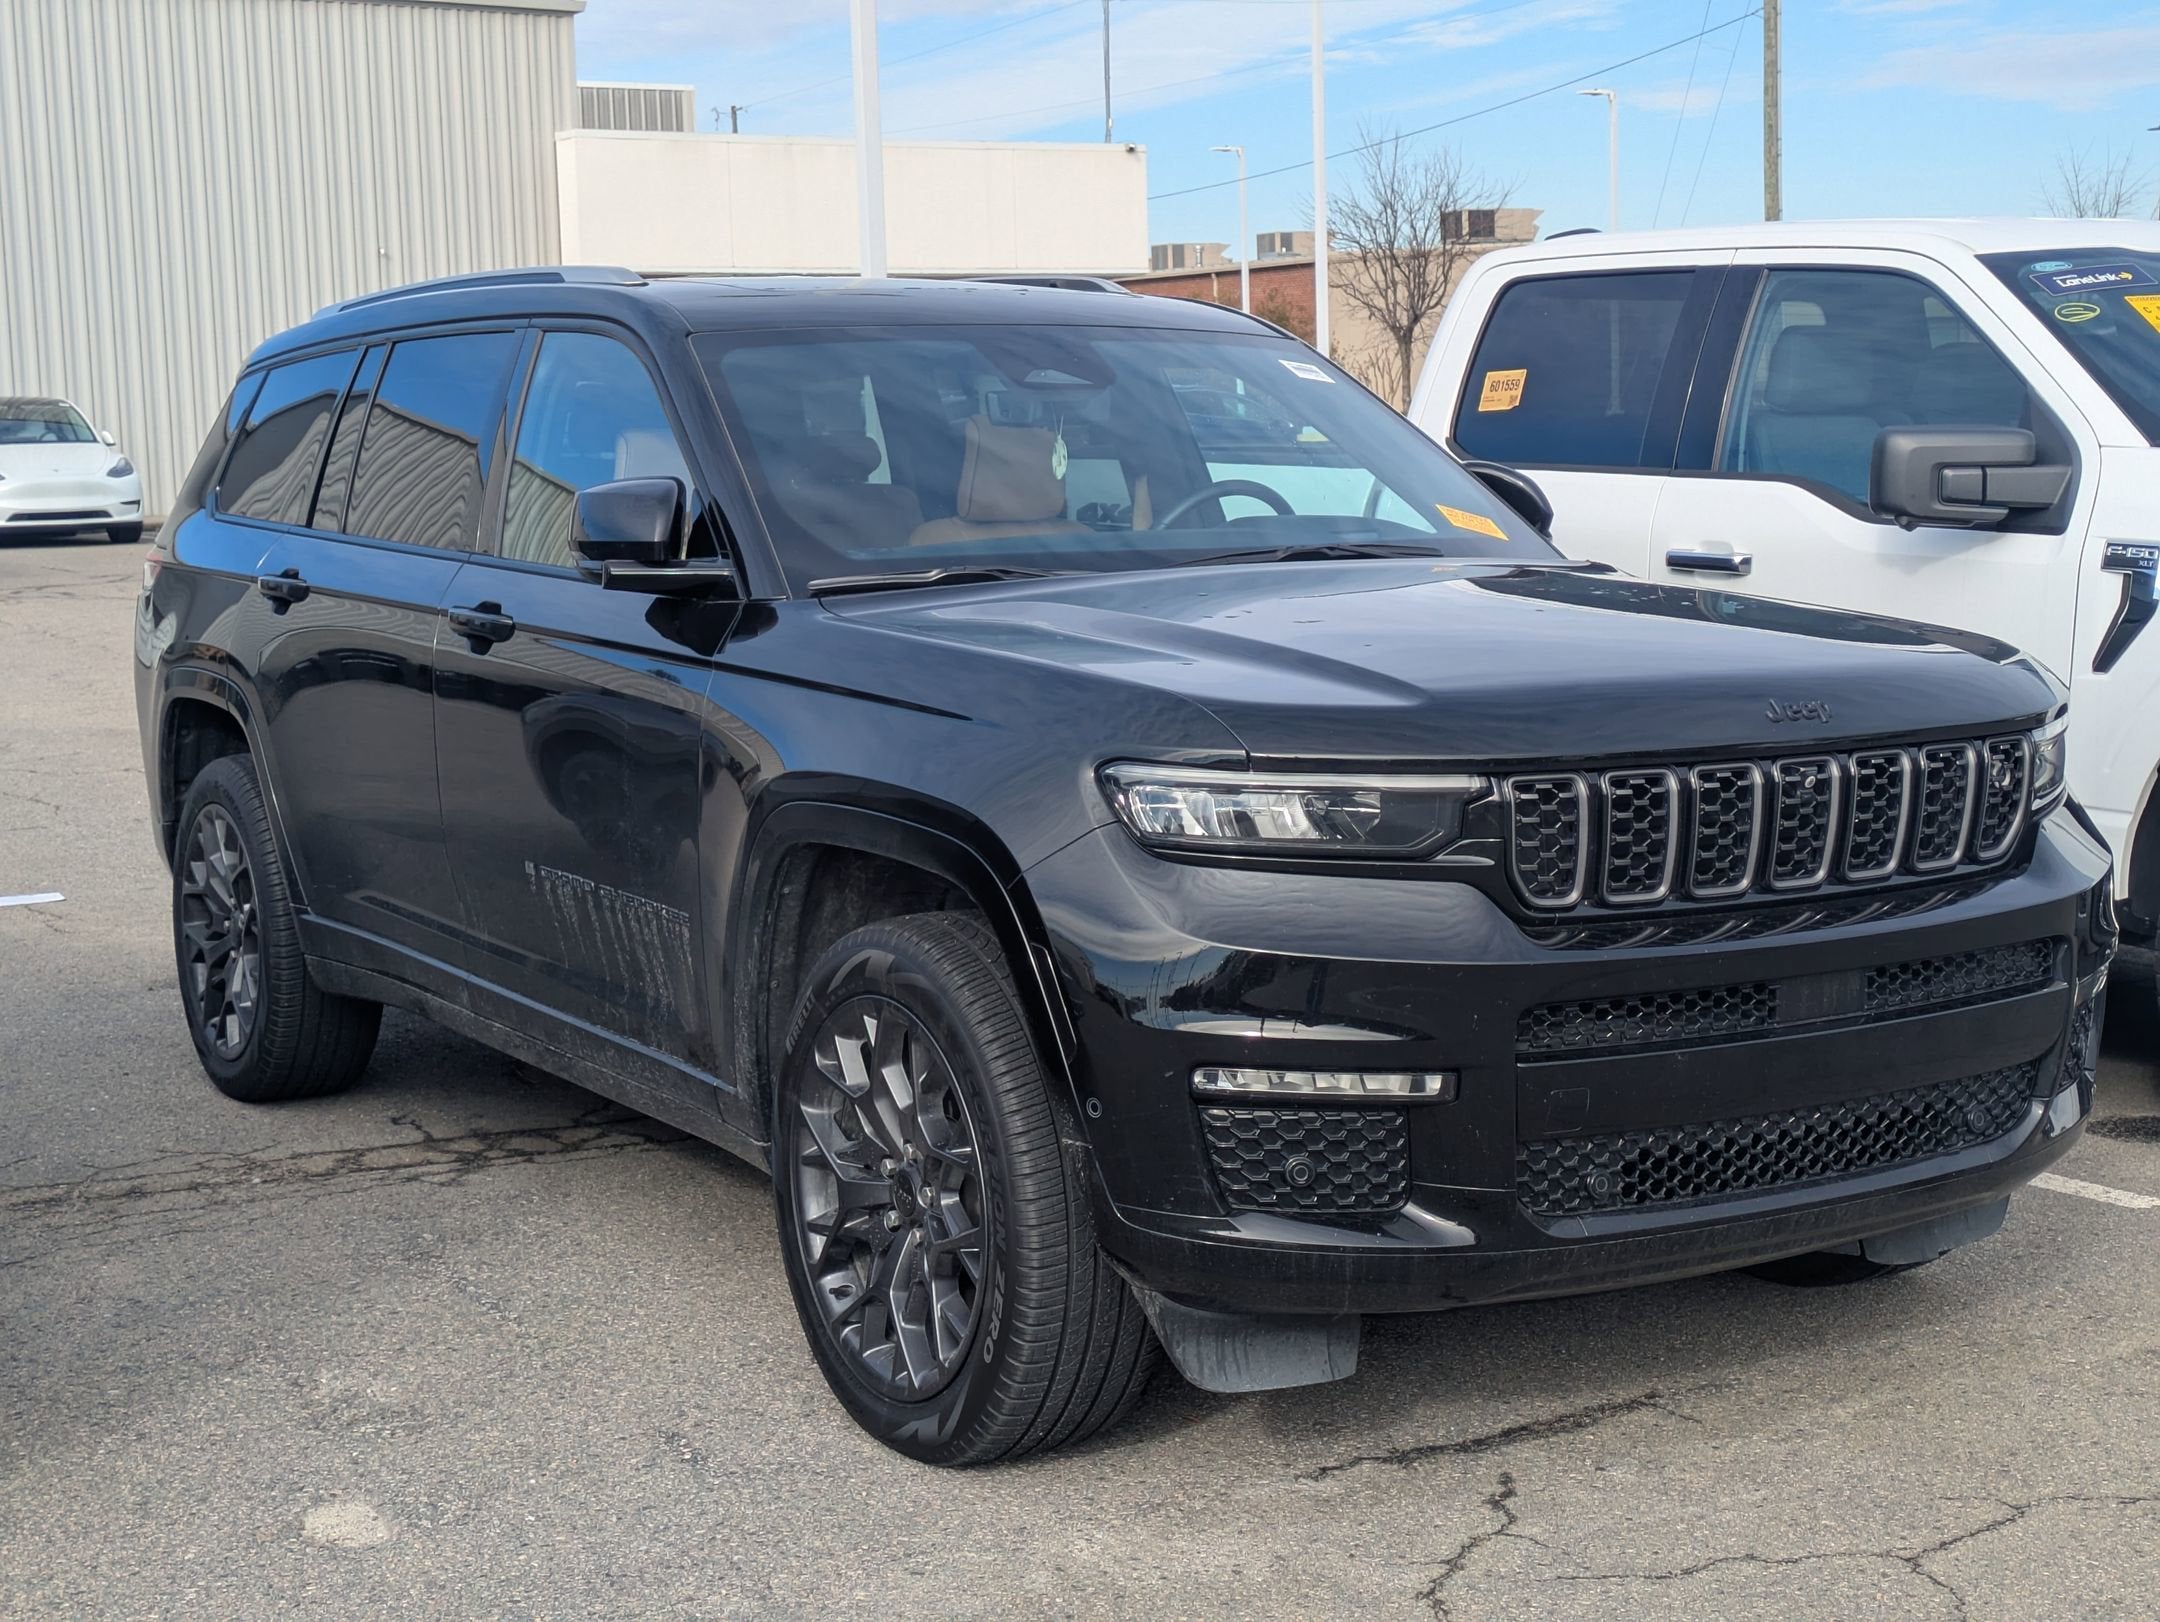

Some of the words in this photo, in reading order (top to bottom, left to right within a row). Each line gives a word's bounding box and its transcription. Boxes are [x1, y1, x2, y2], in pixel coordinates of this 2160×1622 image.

[2056, 272, 2120, 288] LaneLink
[1489, 379, 1521, 392] 601559
[2106, 545, 2159, 559] F-150
[1765, 699, 1832, 723] Jeep
[983, 1260, 1006, 1365] ZERO
